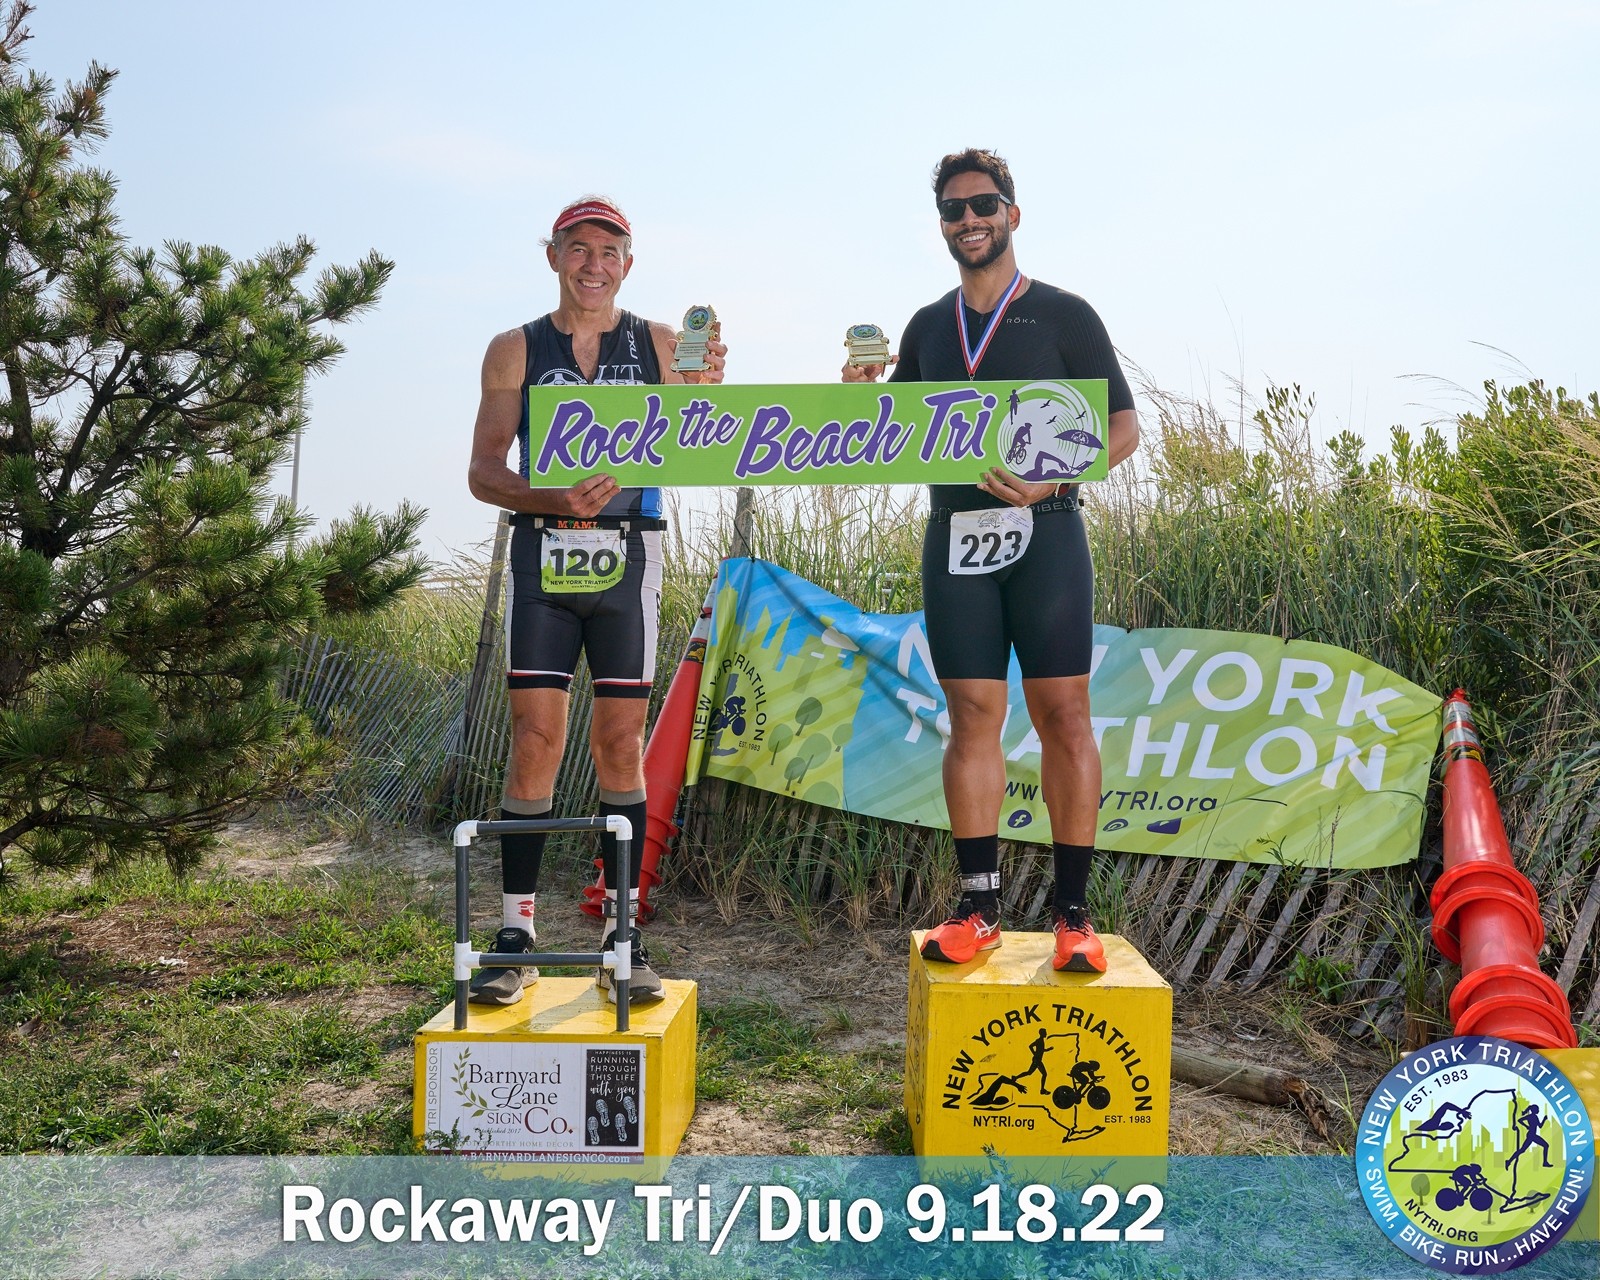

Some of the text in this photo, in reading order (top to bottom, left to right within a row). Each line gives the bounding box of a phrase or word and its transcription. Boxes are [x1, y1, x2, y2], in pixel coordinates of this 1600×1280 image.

[626, 330, 638, 360] 2XU
[535, 394, 670, 475] Rock
[677, 398, 744, 448] the
[733, 394, 916, 480] Beach
[919, 388, 998, 463] Tri
[549, 548, 618, 577] 120
[959, 530, 1023, 568] 223
[584, 577, 617, 585] TRIATHLON
[693, 693, 712, 740] NEW
[734, 652, 767, 741] RIATHLON
[1139, 647, 1406, 737] YORK
[748, 742, 761, 752] 1983
[590, 1056, 636, 1064] RUNNING
[942, 1049, 975, 1110] NEW
[971, 1004, 1042, 1047] YORK
[1051, 1003, 1153, 1112] TRIATHLON
[427, 1047, 438, 1106] SPONSOR
[469, 1064, 562, 1091] Barnyard
[491, 1083, 558, 1110] Lane
[590, 1080, 636, 1103] with you
[487, 1106, 574, 1135] SIGN Co.
[973, 1115, 1035, 1131] NYTRI.org
[1104, 1115, 1151, 1124] EST. 1983
[519, 1140, 542, 1148] HOME
[546, 1140, 574, 1148] DECOR
